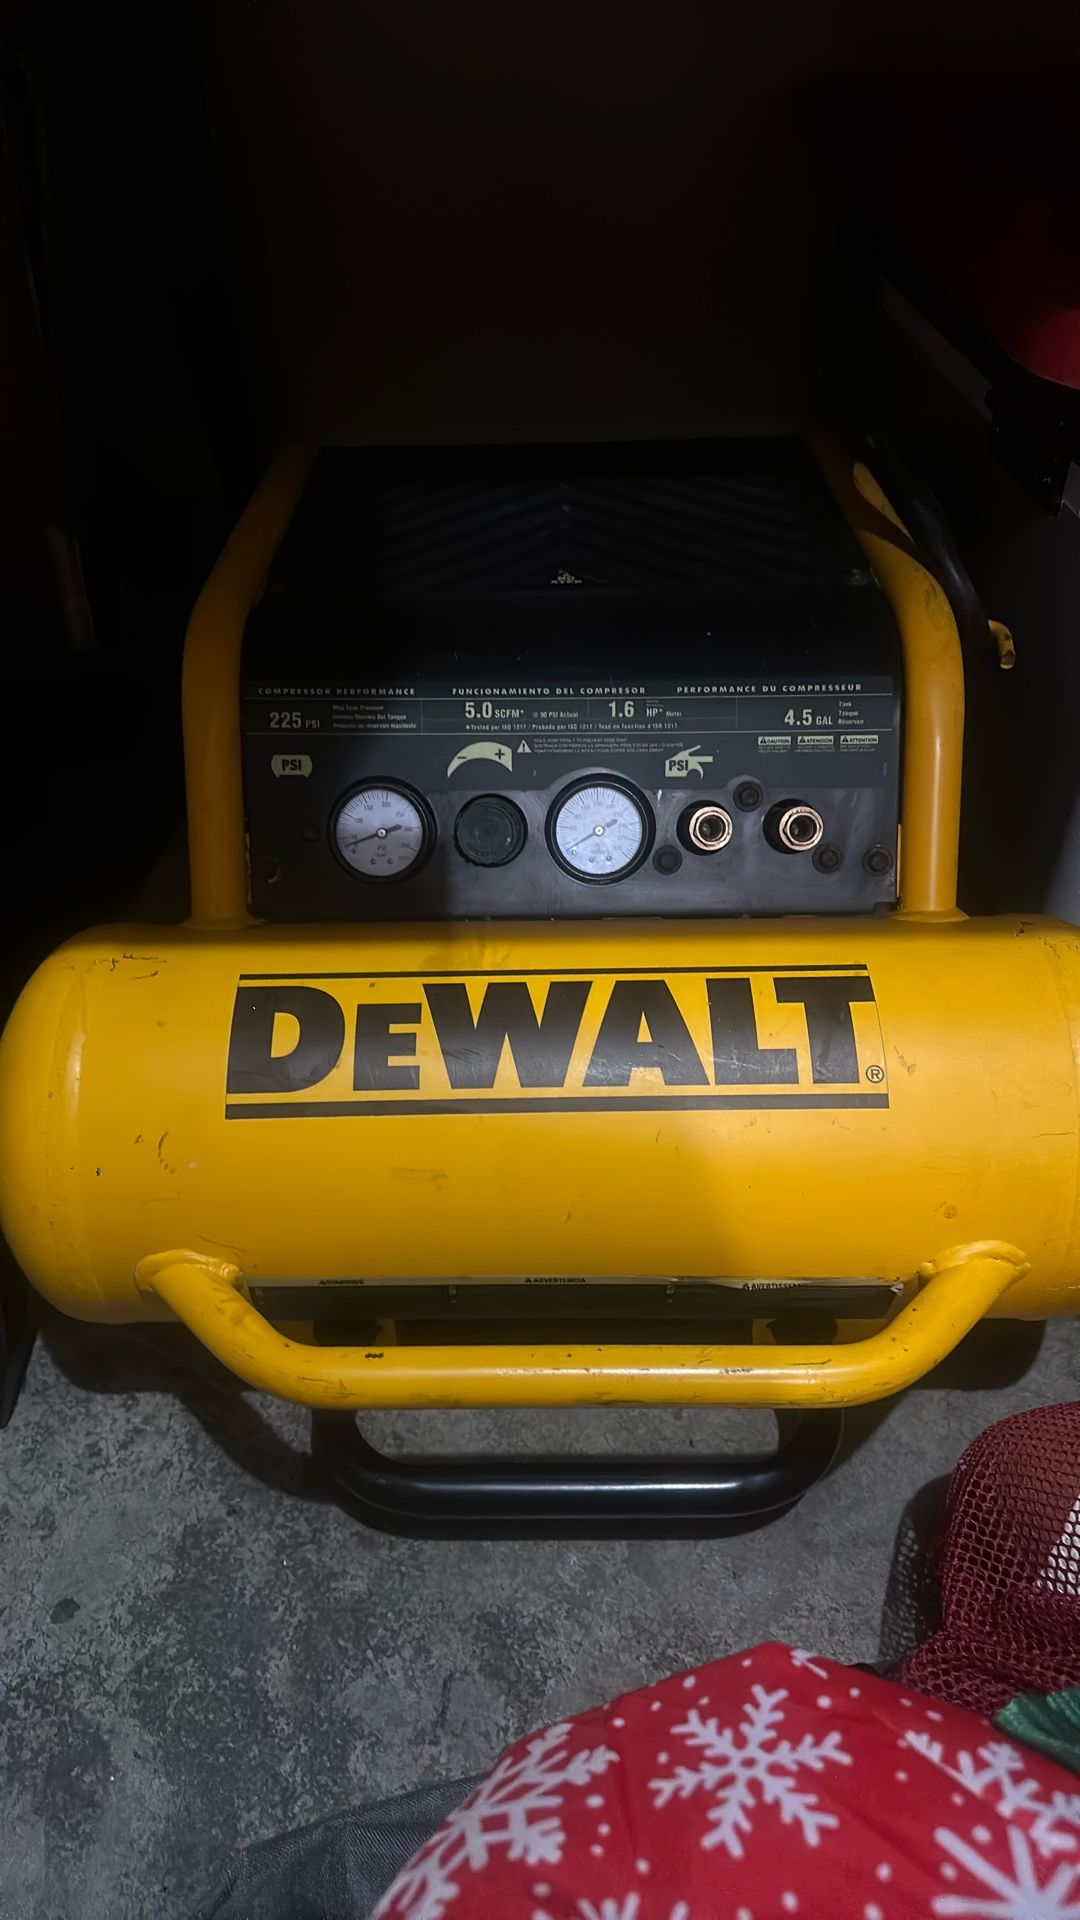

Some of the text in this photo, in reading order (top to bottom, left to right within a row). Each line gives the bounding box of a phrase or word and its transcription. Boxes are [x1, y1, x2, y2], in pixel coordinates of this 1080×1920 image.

[258, 687, 415, 696] COMPRESSOR PERFORMANCE
[452, 687, 646, 696] FUNCIONAMIENTO DEL COMPRESOR
[677, 684, 862, 694] PERFORMANCE DU COMPRESSEUR
[465, 701, 492, 719] 5.0
[608, 700, 635, 718] 1.6
[838, 700, 852, 708] Tank
[269, 711, 321, 729] 225 PSI
[784, 708, 833, 726] 4.5 GAL
[281, 759, 302, 771] PSI
[668, 759, 689, 772] PSI
[226, 976, 876, 1094] DEWALT
